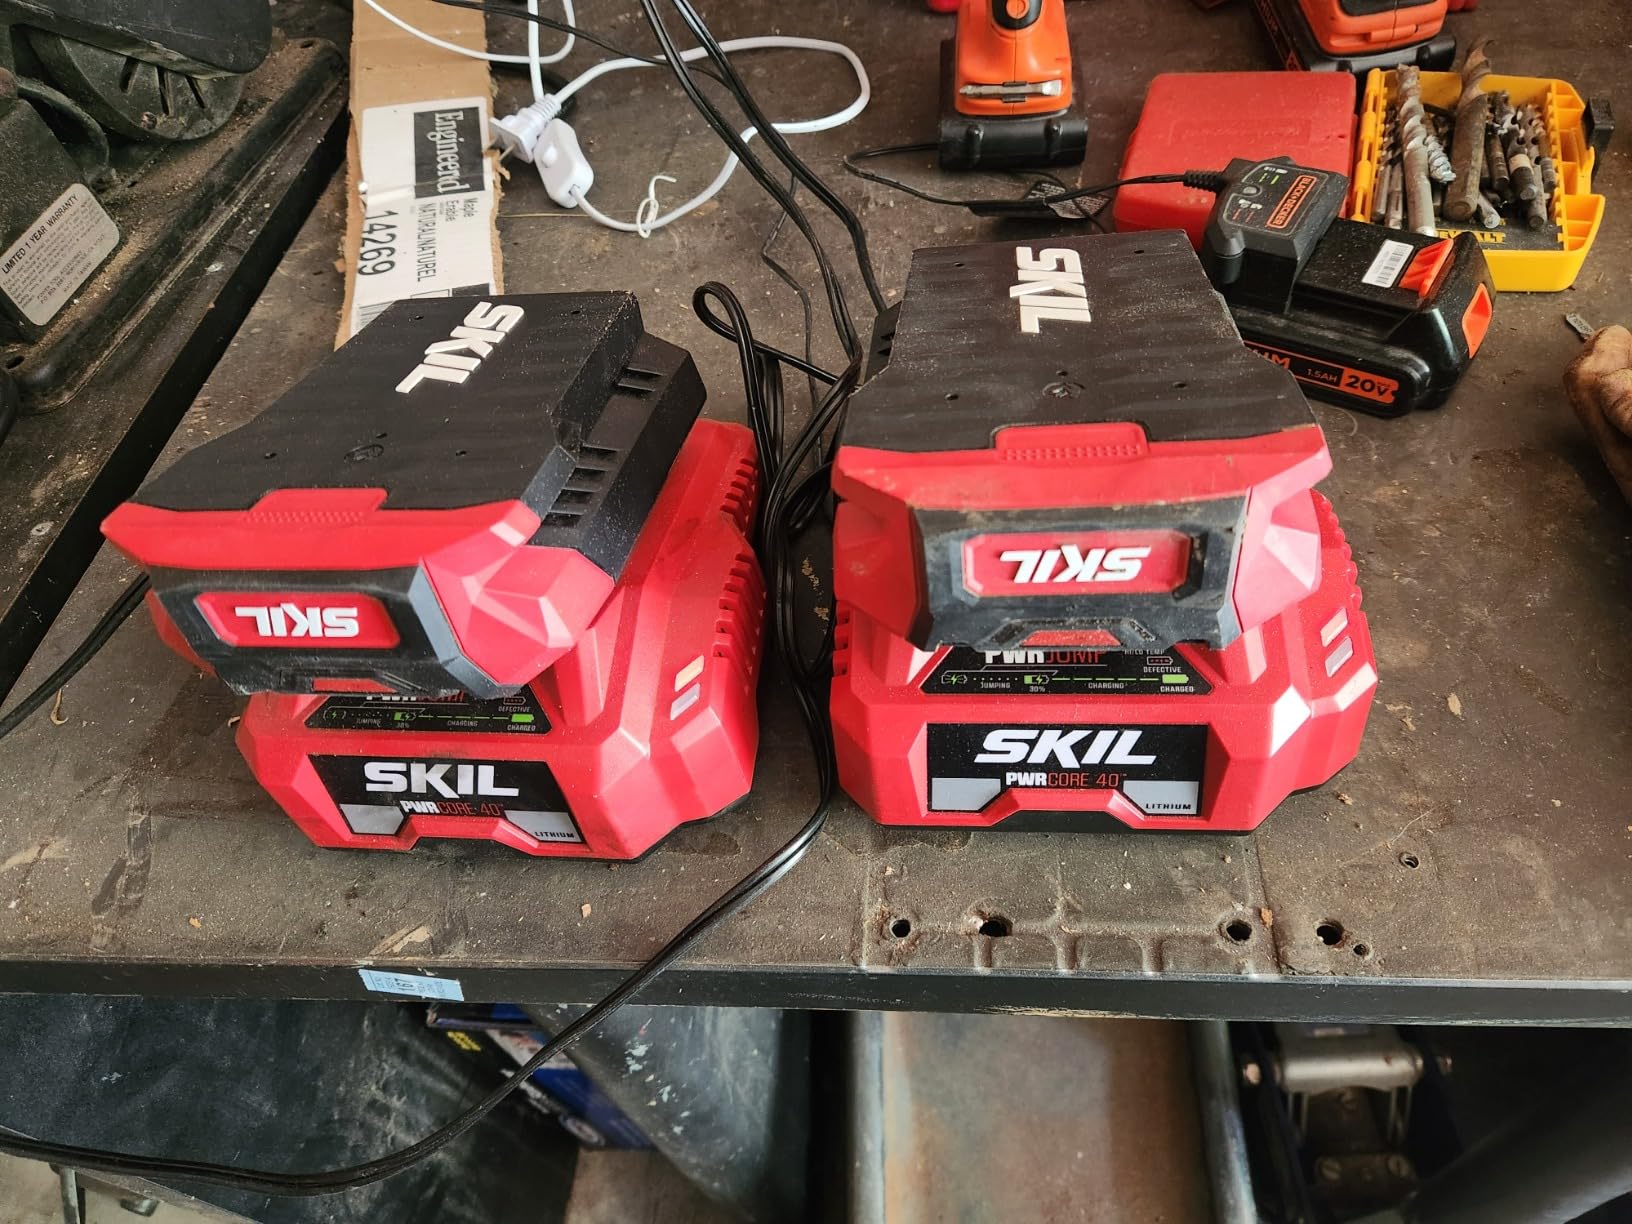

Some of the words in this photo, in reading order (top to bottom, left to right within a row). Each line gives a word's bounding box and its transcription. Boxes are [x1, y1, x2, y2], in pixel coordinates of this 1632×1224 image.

[463, 198, 478, 218] Maple
[2, 247, 26, 274] LIMITED
[30, 225, 48, 244] YEAR
[46, 194, 79, 227] WARRANTY
[358, 210, 399, 276] 14269
[1009, 246, 1091, 333] SKIL
[395, 301, 525, 394] SKIL
[1306, 368, 1338, 383] 1.5AH
[1000, 544, 1152, 584] SKIL
[234, 602, 360, 638] SKIL
[980, 681, 1011, 689] JUMPING
[1160, 685, 1194, 693] CHARGED
[447, 719, 479, 728] CHARGING
[507, 724, 536, 732] CHARGED
[974, 729, 1157, 769] SKIL
[364, 761, 519, 799] SKIL
[1006, 772, 1089, 786] PWRCORE
[400, 800, 476, 815] PWRCORE
